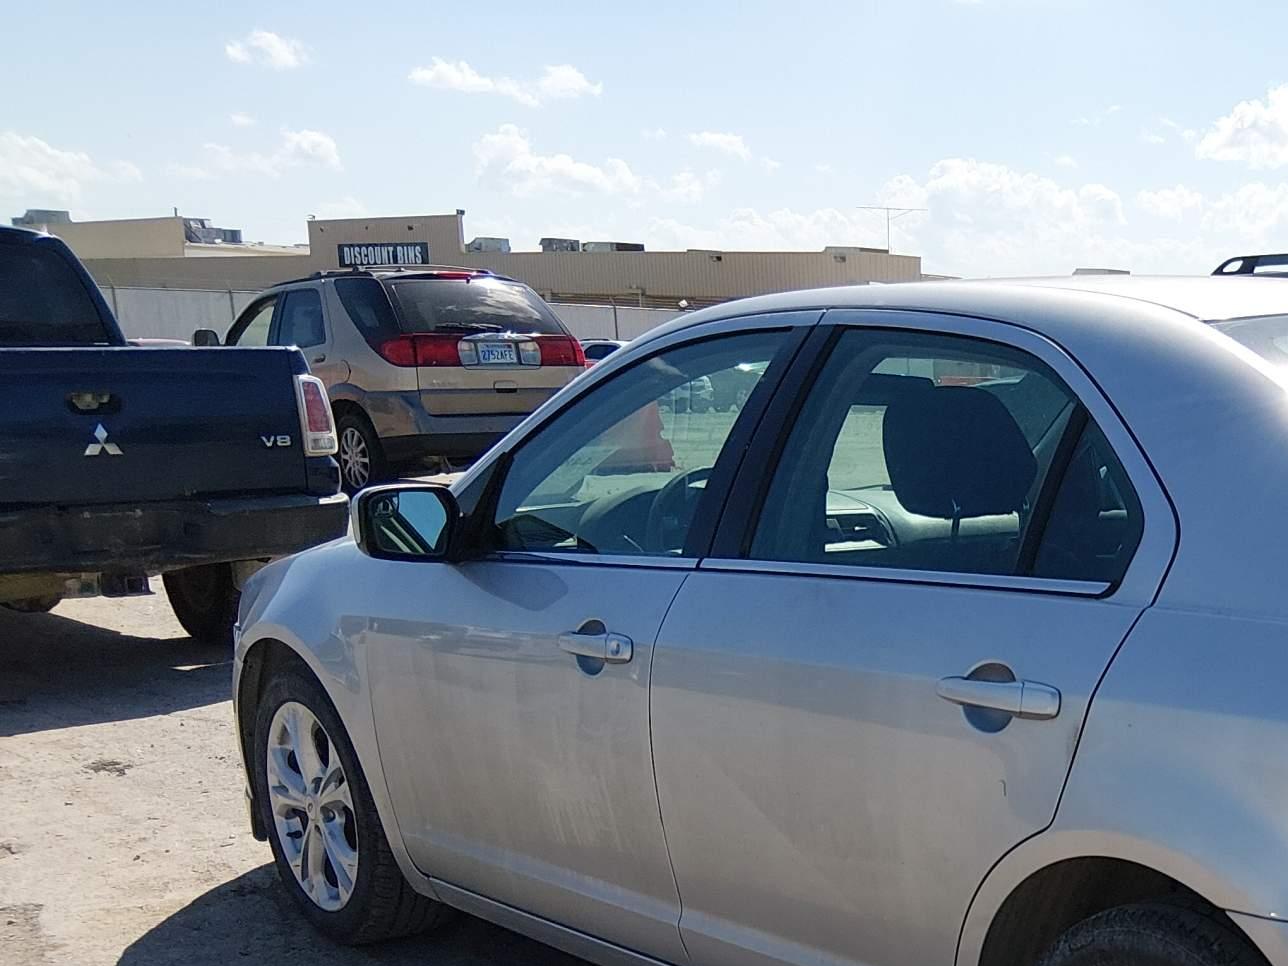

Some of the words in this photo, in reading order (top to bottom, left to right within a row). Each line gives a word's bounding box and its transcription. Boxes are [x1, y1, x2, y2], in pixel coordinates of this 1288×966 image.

[343, 246, 394, 265] DISCOUNT
[396, 245, 423, 264] BINS
[260, 435, 292, 447] V8
